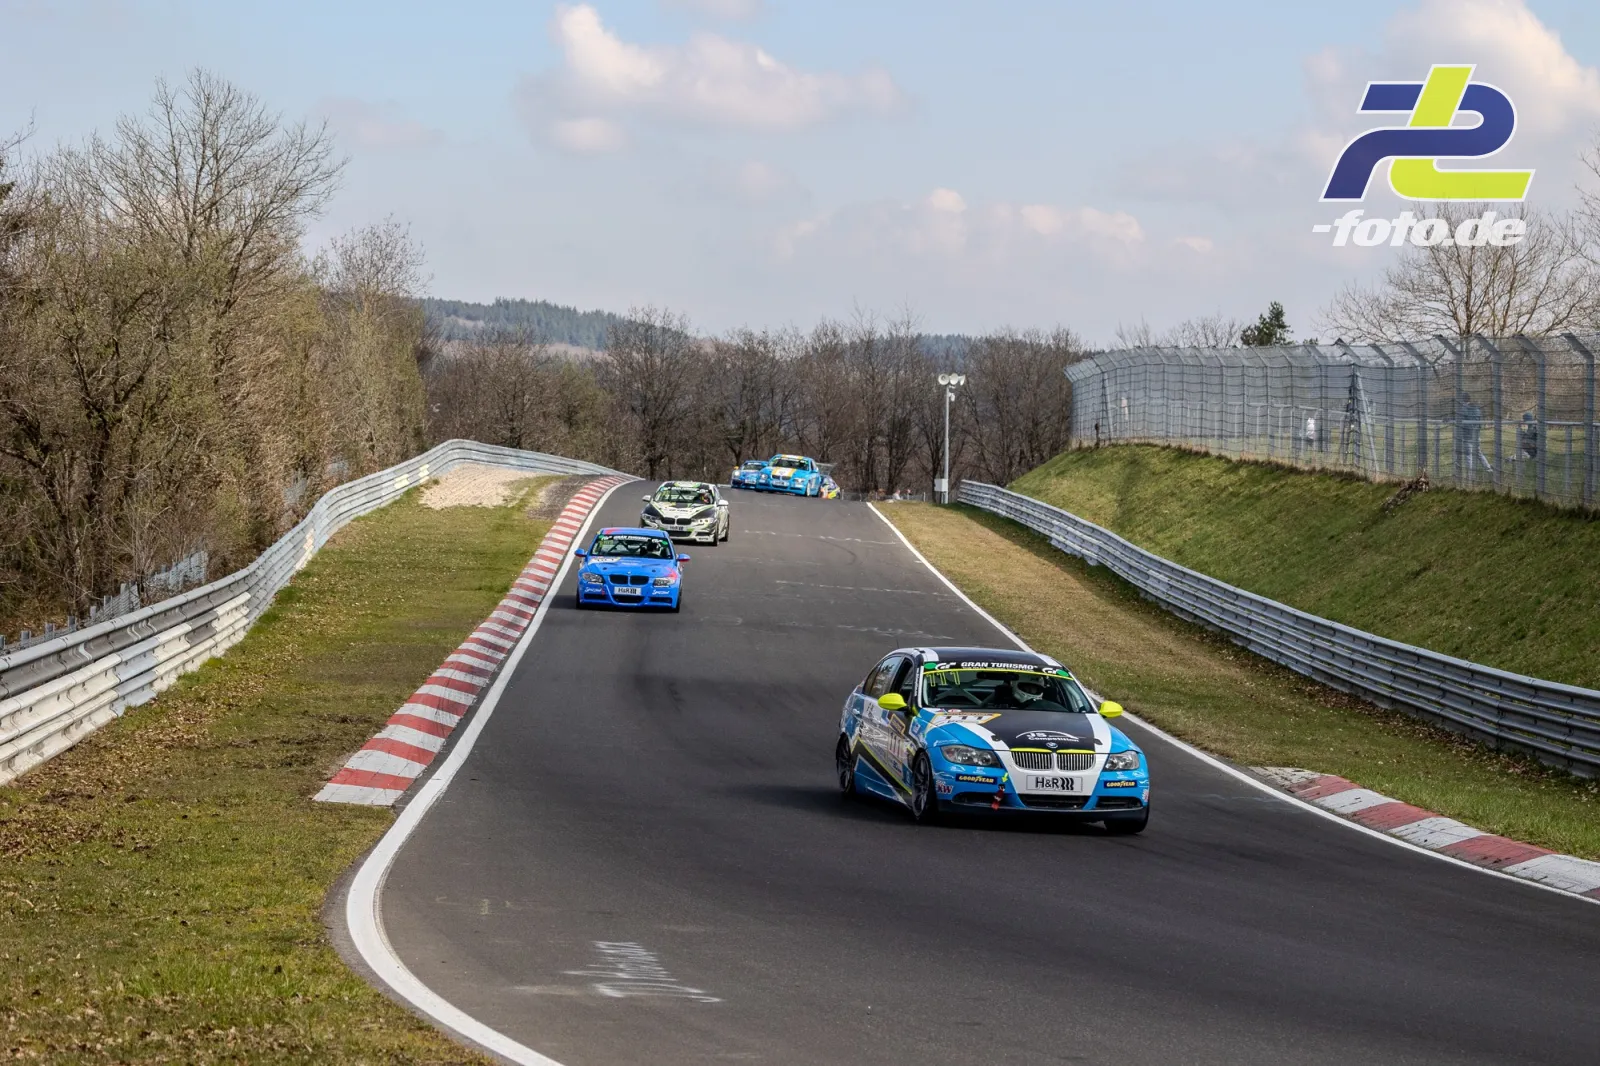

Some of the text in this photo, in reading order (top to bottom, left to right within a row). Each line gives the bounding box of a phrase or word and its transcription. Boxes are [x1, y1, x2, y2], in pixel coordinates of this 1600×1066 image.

[991, 662, 1034, 670] TURISMO
[926, 671, 961, 687] 111
[958, 775, 995, 783] GOODYEAR
[1035, 777, 1059, 789] H&R
[1106, 780, 1136, 788] GOODYEAR
